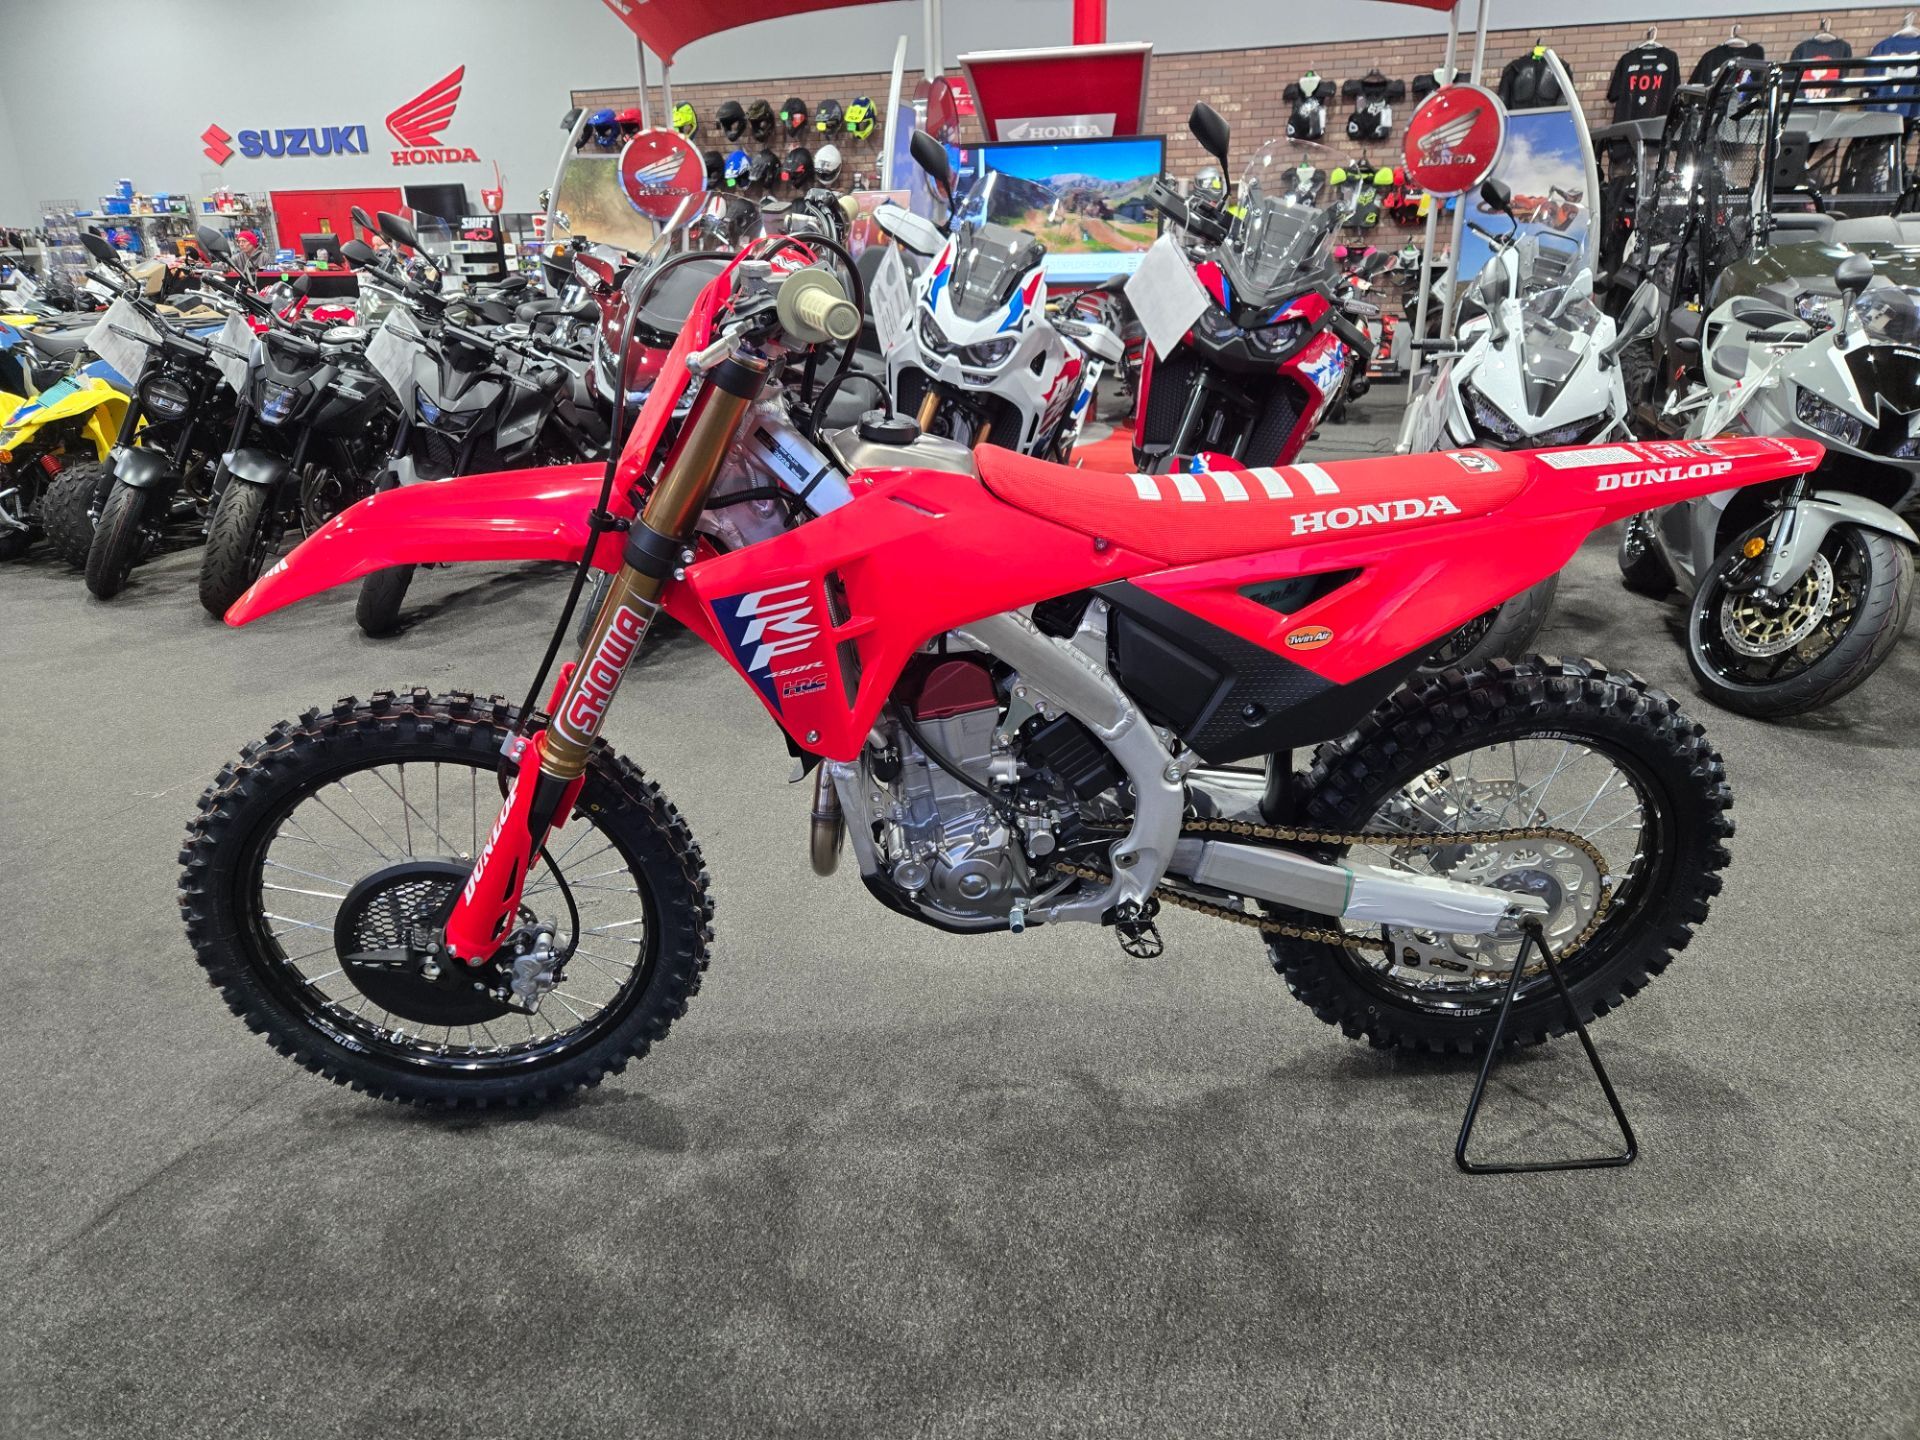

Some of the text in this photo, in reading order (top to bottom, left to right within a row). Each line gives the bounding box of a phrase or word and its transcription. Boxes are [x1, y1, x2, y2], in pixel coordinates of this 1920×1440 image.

[1629, 75, 1663, 91] FOX
[237, 125, 368, 158] SUZUKI
[1029, 125, 1103, 139] HONDA
[391, 148, 480, 165] HONDA
[461, 217, 494, 229] SHIFT
[1596, 461, 1733, 492] DUNLOP
[1290, 495, 1462, 536] HONDA
[735, 580, 821, 673] CRF
[1289, 631, 1331, 646] Twin Air
[566, 605, 649, 736] SHOWA
[464, 774, 521, 907] DUNLOP
